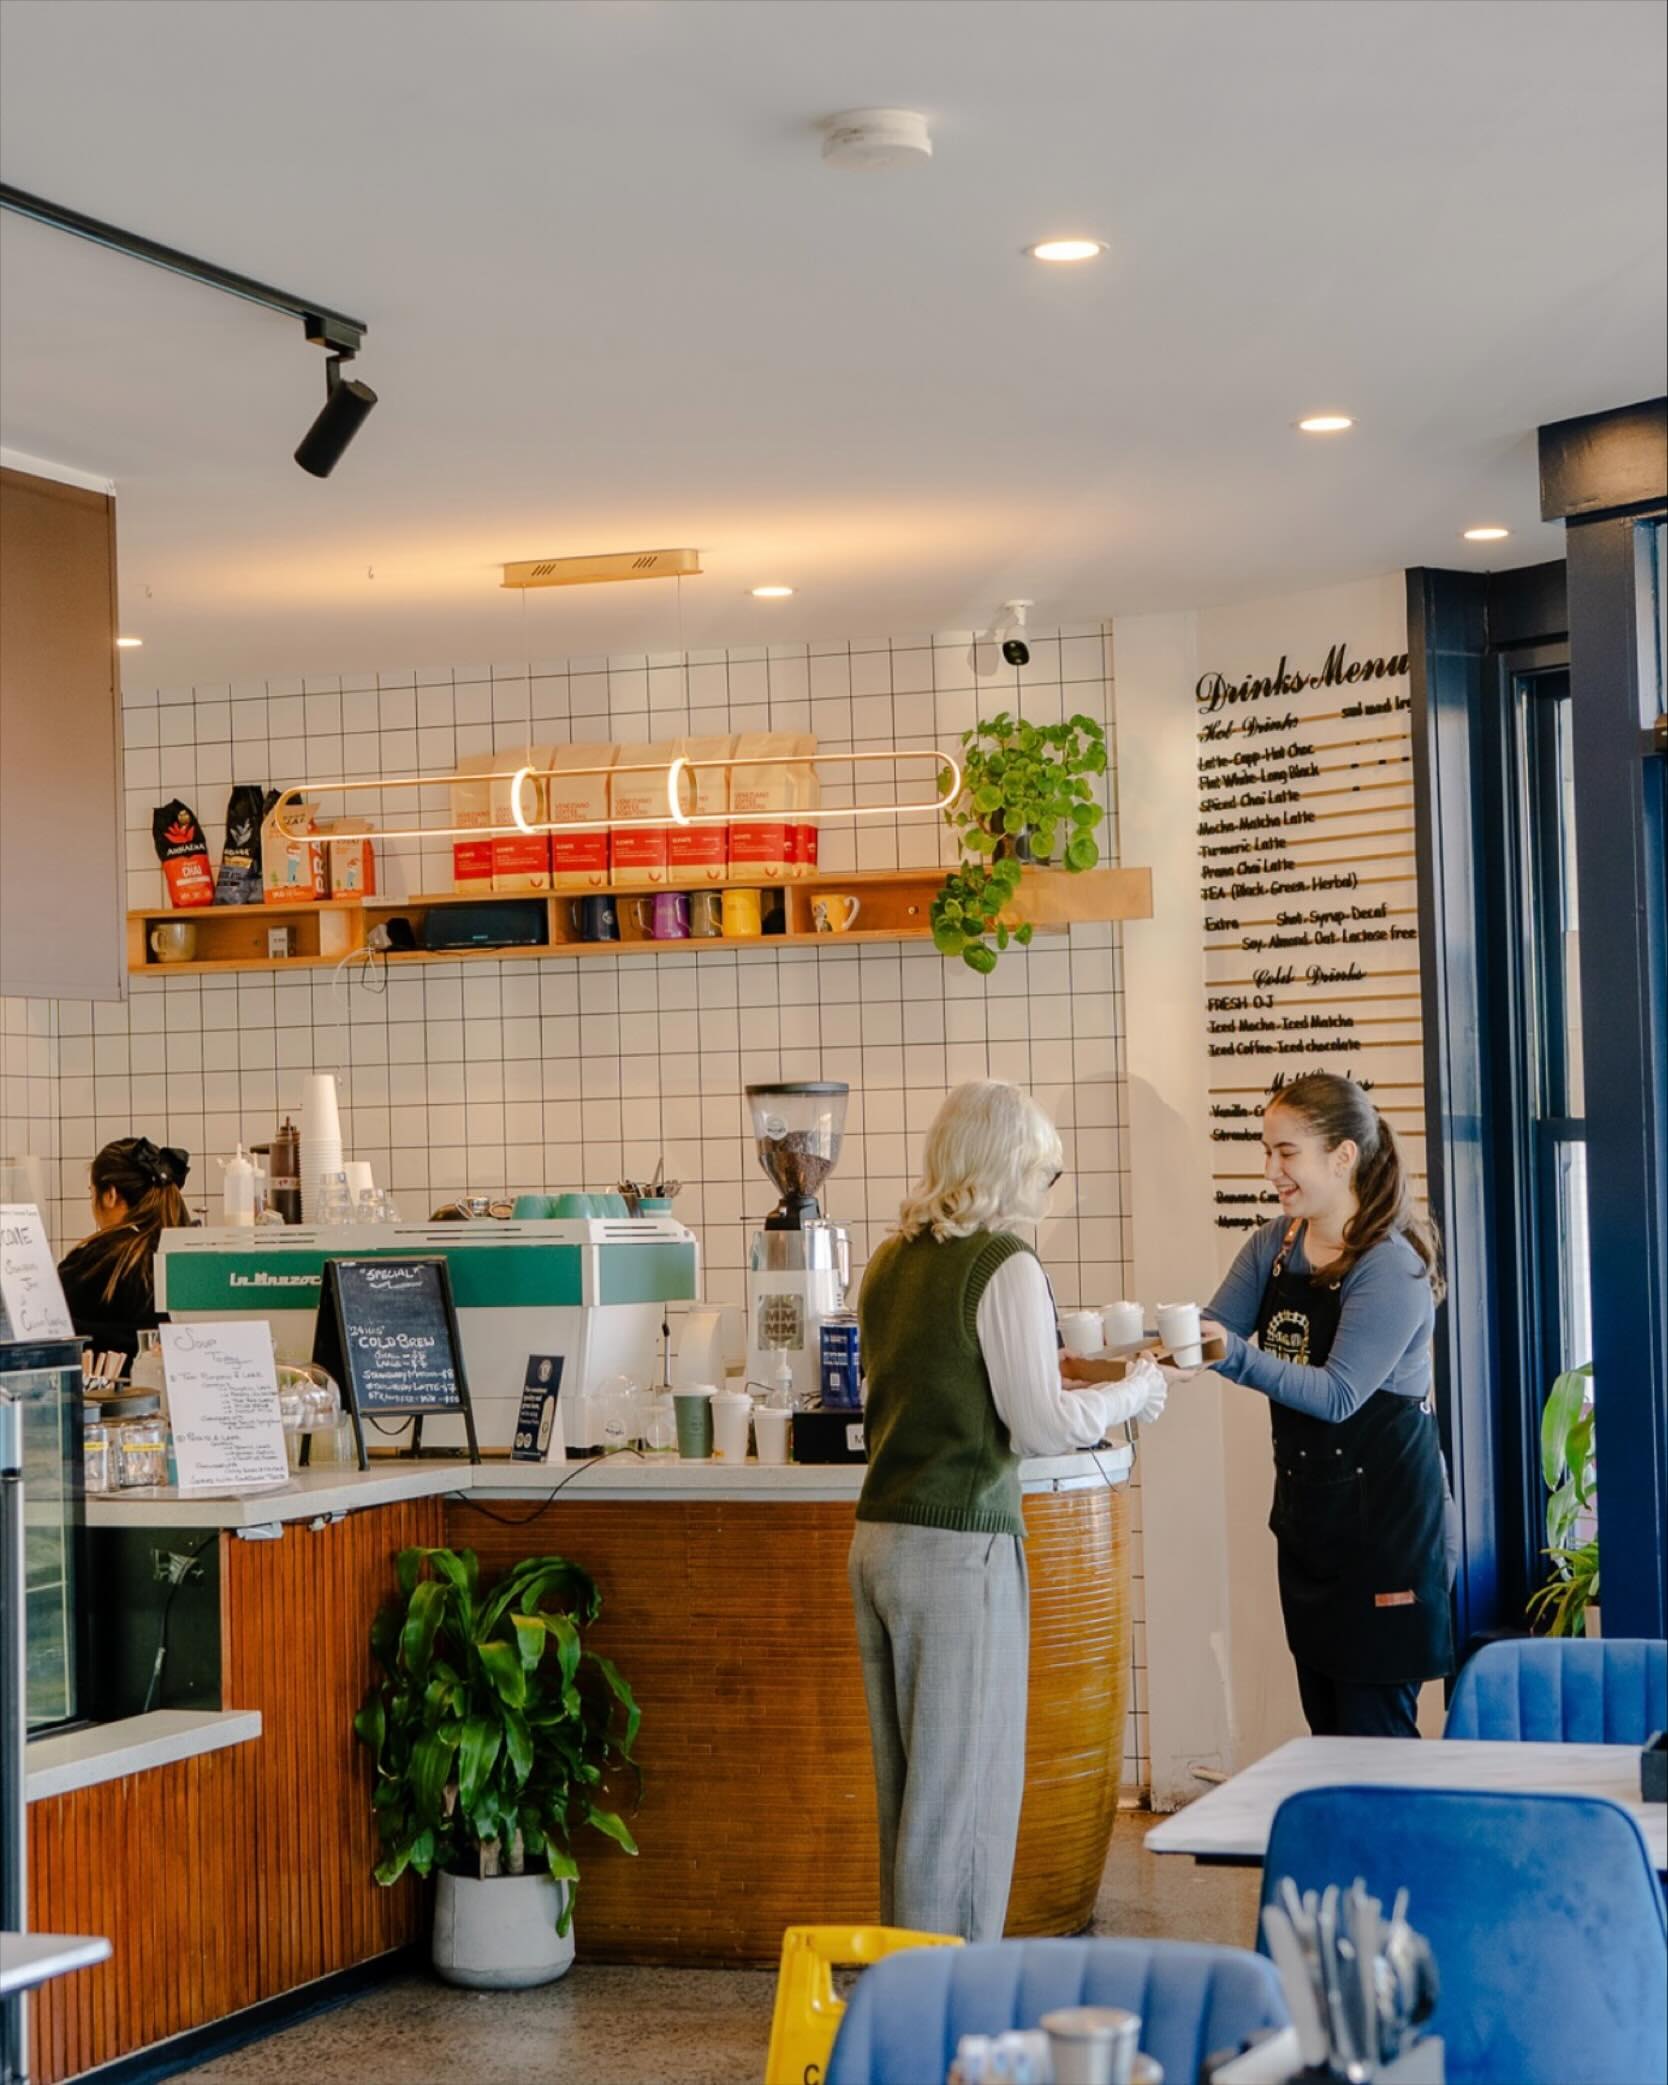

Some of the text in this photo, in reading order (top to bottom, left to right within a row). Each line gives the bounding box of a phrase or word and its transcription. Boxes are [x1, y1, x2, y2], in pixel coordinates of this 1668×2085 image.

[1196, 643, 1409, 714] Drinks Menu
[1198, 713, 1299, 742] Hot Drinks
[1287, 742, 1315, 758] Choc
[1199, 776, 1220, 790] Flat
[1289, 762, 1319, 779] Black
[1240, 790, 1266, 807] Chai
[1268, 790, 1300, 804] Latte
[1283, 810, 1315, 825] Latte
[1198, 837, 1286, 858] Turmeric Latte
[1237, 858, 1262, 875] Chai
[1264, 858, 1295, 873] Latte
[1201, 885, 1227, 900] TEA
[1204, 917, 1239, 931] Extra
[1390, 924, 1417, 941] free
[1252, 961, 1366, 988] Cold Drinks
[1207, 996, 1248, 1011] FRESH
[1208, 1019, 1235, 1033] Iced
[1311, 1013, 1354, 1028] Matcha
[1208, 1041, 1235, 1057] Iced
[1306, 1036, 1361, 1052] chocolate
[359, 1333, 436, 1350] COLD BREW
